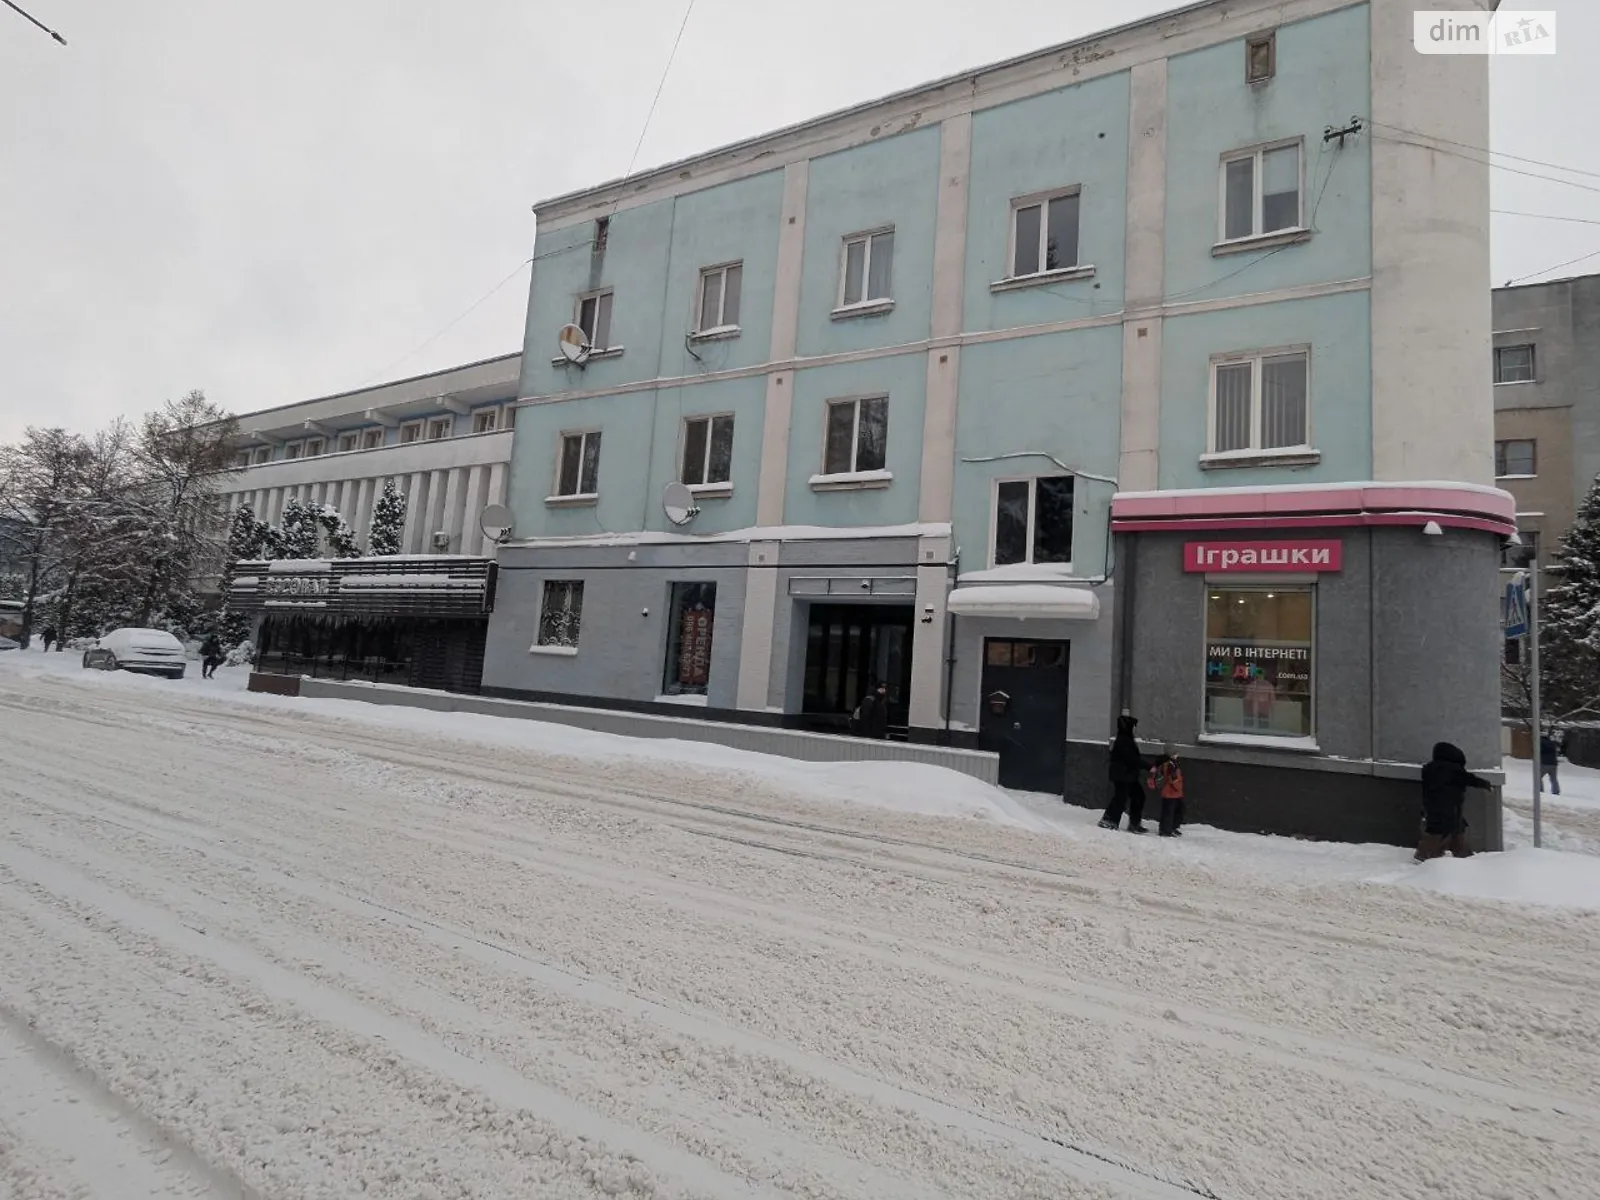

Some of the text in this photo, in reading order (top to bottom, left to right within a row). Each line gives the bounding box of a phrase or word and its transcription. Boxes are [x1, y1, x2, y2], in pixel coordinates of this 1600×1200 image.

[1197, 546, 1330, 569] Іграшки
[1209, 646, 1307, 660] МИ В ІНТЕРНЕТІ
